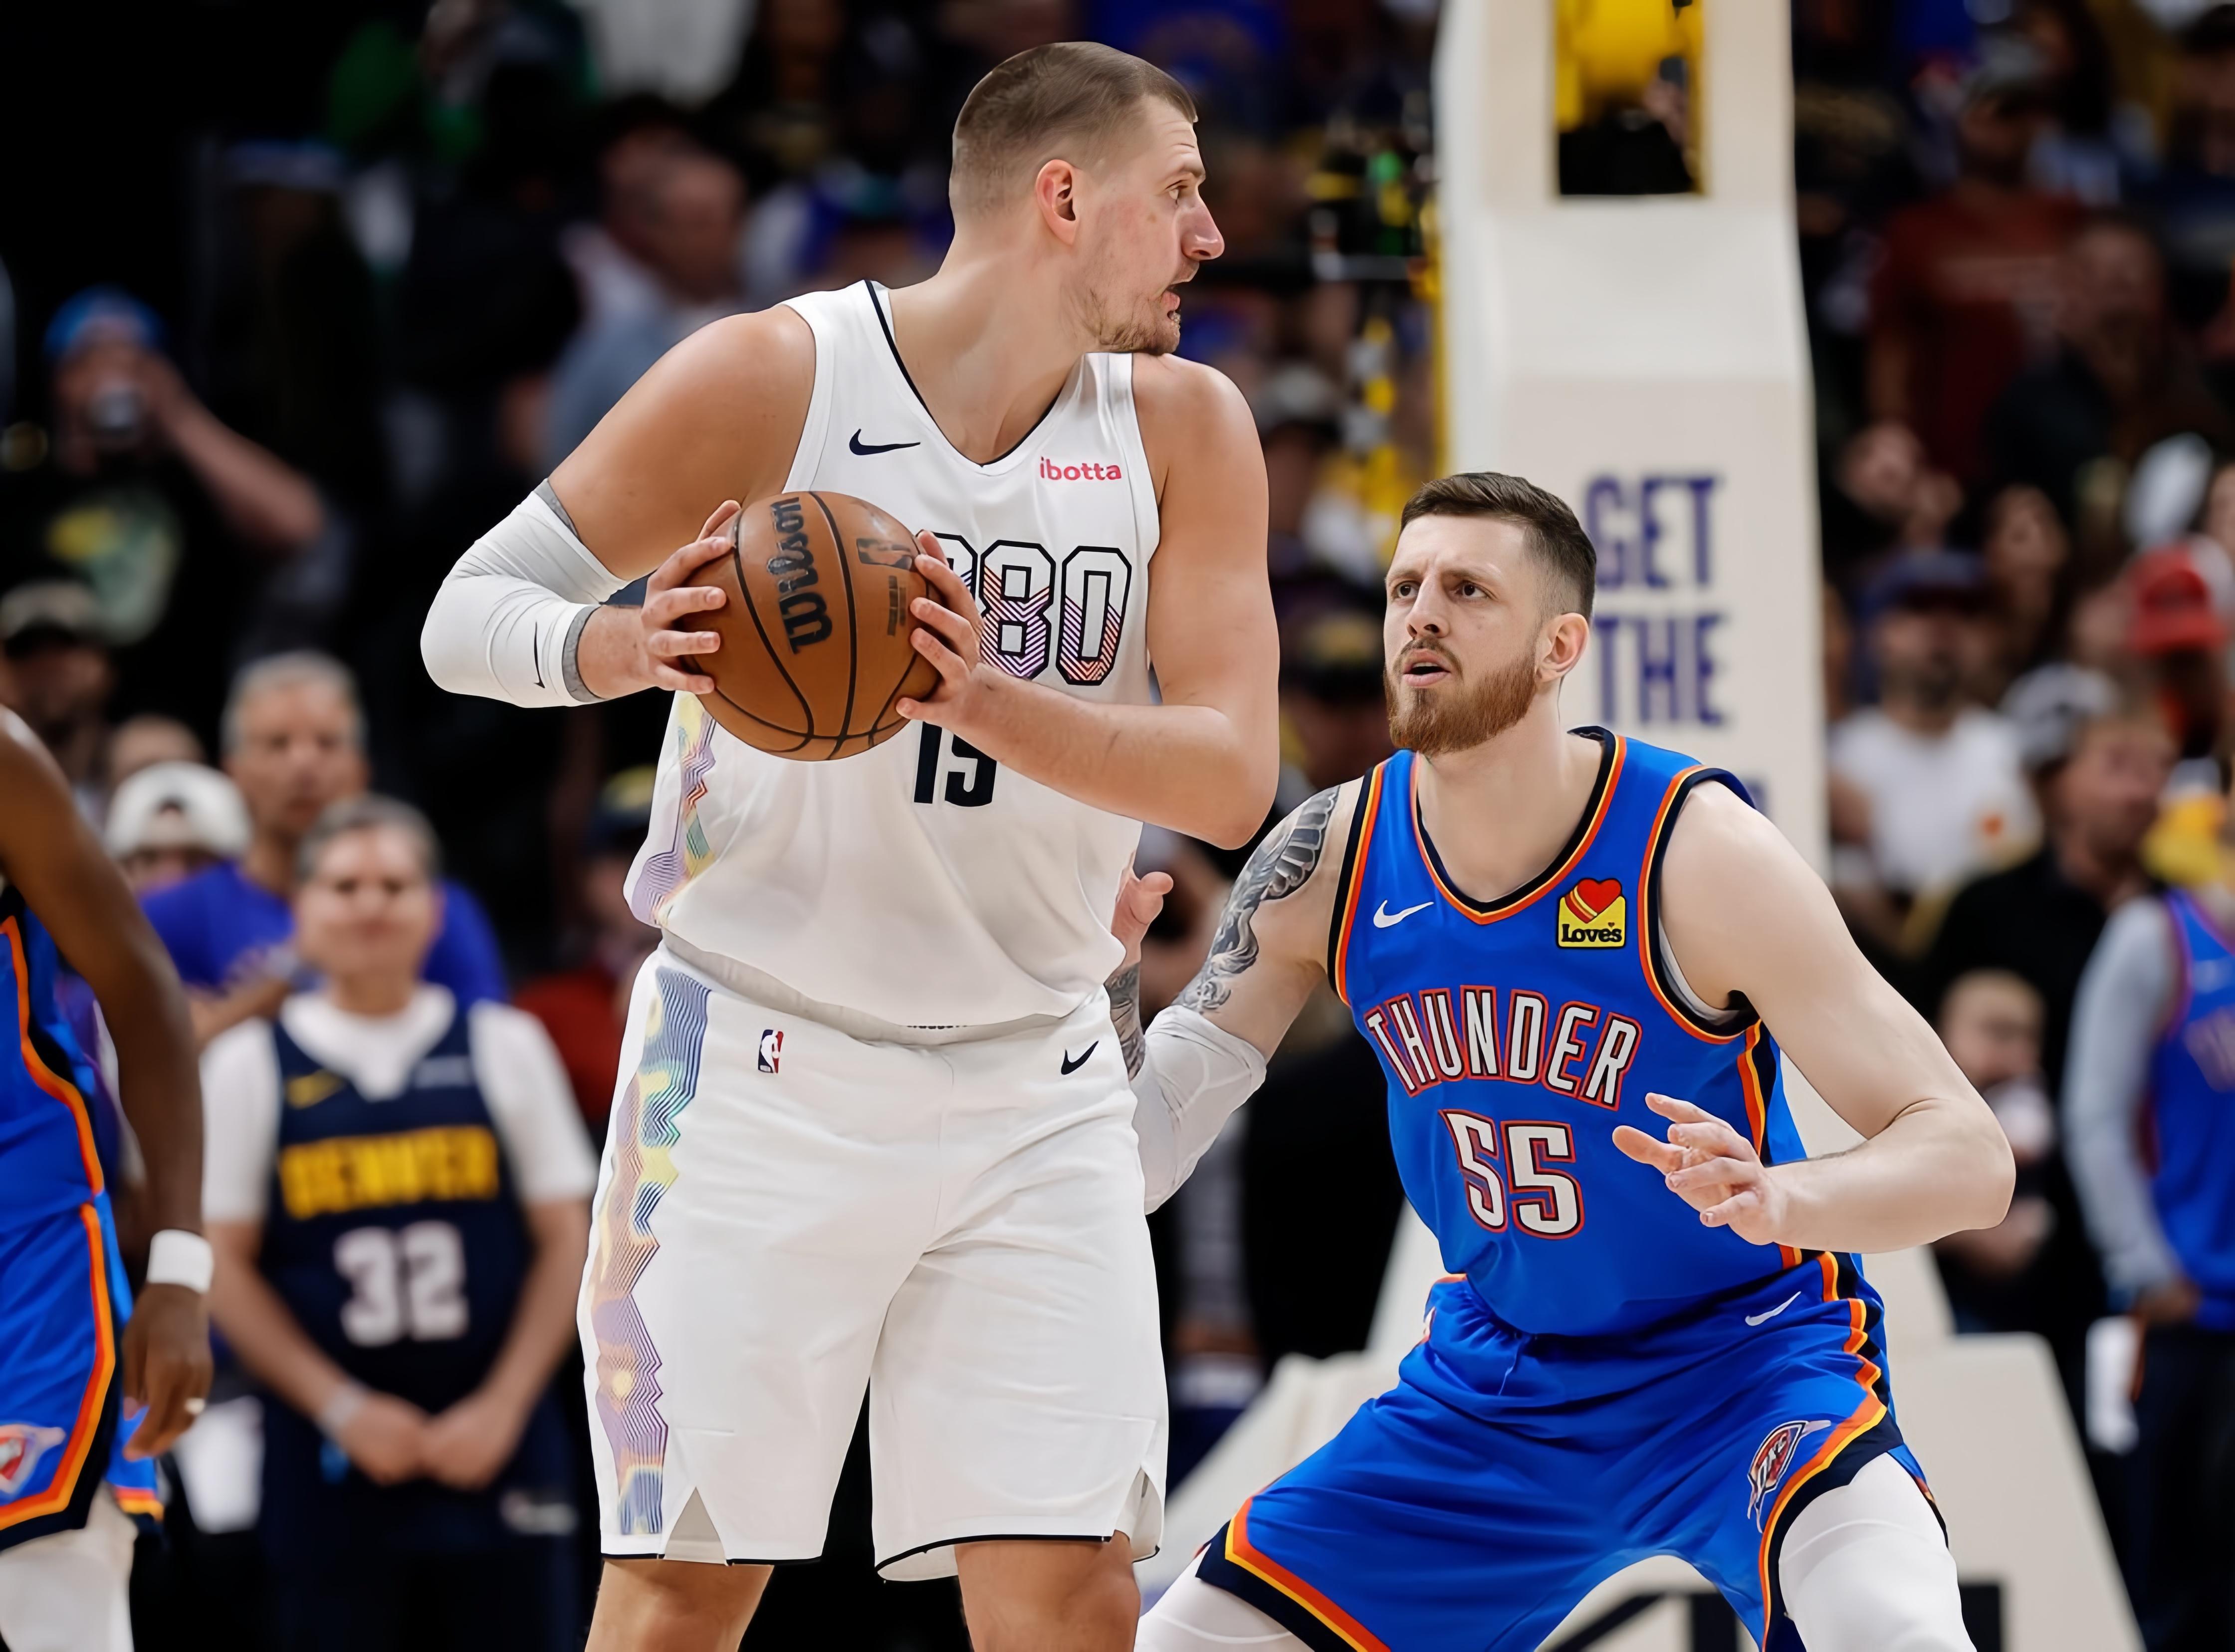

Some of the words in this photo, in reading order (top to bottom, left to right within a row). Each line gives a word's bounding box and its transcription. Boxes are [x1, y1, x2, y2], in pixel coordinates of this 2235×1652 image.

[1040, 456, 1121, 480] ibotta
[767, 497, 833, 655] Wilson
[1584, 474, 1721, 589] GET
[1592, 613, 1726, 726] THE
[914, 721, 997, 807] 15
[1366, 985, 1642, 1111] THUNDER
[1438, 1109, 1584, 1239] 55
[333, 1221, 468, 1345] 32
